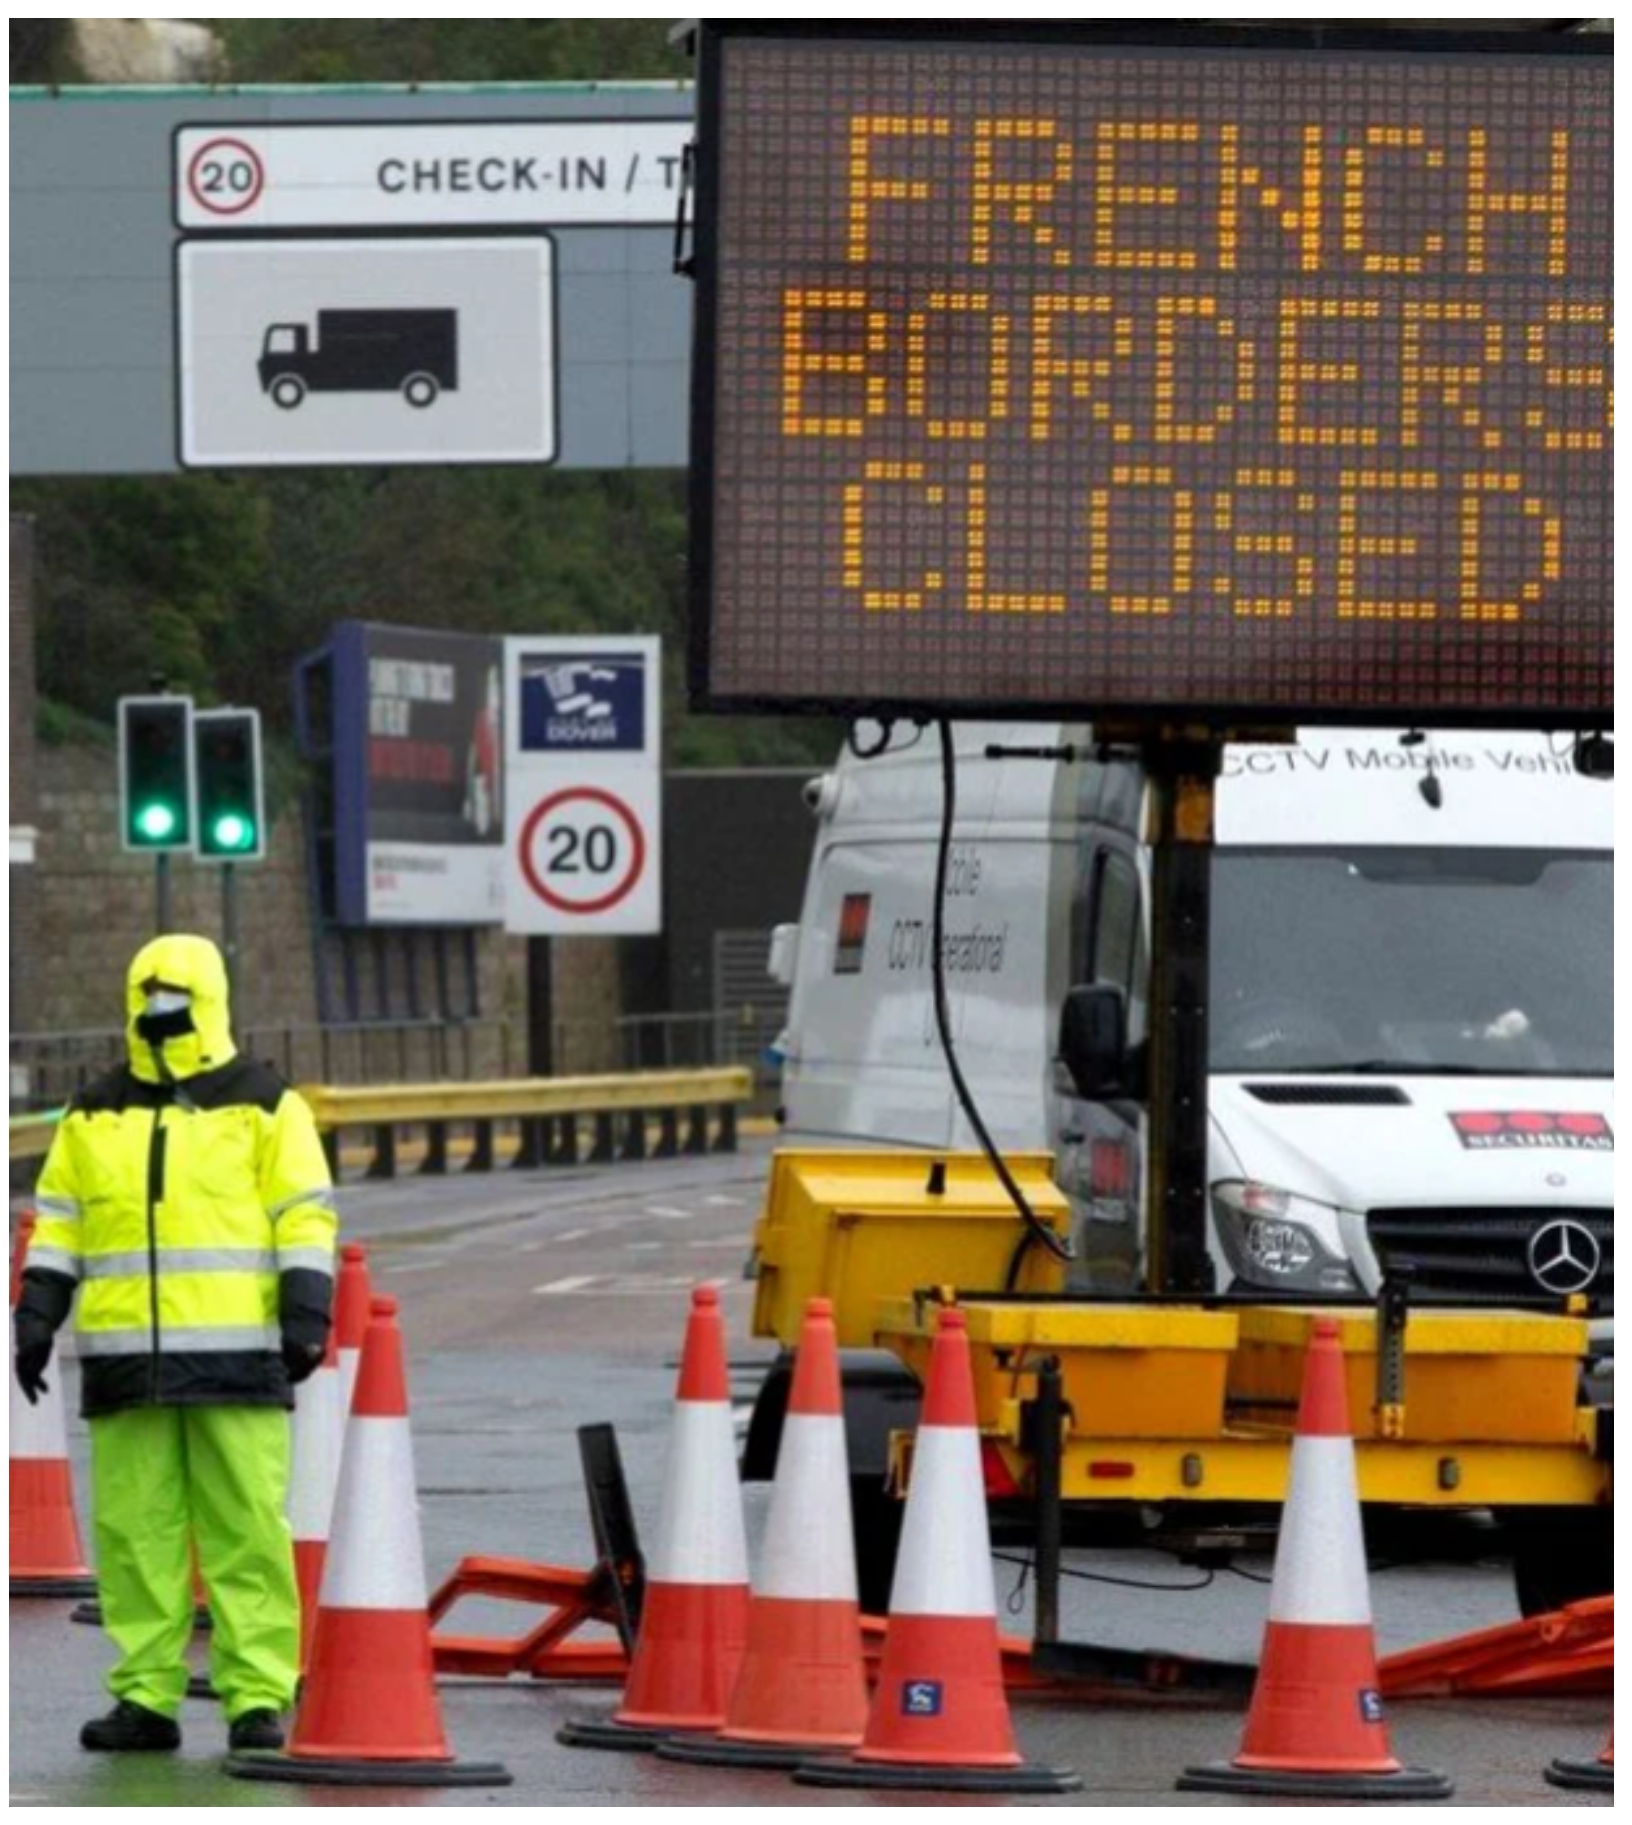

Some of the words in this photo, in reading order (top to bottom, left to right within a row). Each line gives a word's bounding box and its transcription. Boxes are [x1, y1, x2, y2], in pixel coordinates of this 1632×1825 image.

[199, 160, 254, 194] 20
[376, 157, 607, 194] CHECK-IN
[850, 115, 1570, 277] FRENCH
[782, 287, 1614, 451] BORDERS
[842, 460, 1563, 621] CLOSED
[546, 725, 617, 742] DOVER
[1222, 748, 1332, 777] CCTV
[1345, 747, 1476, 773] Mobile
[1483, 749, 1572, 775] Vehi
[546, 825, 617, 875] 20
[1467, 1132, 1614, 1149] SECURITAS
